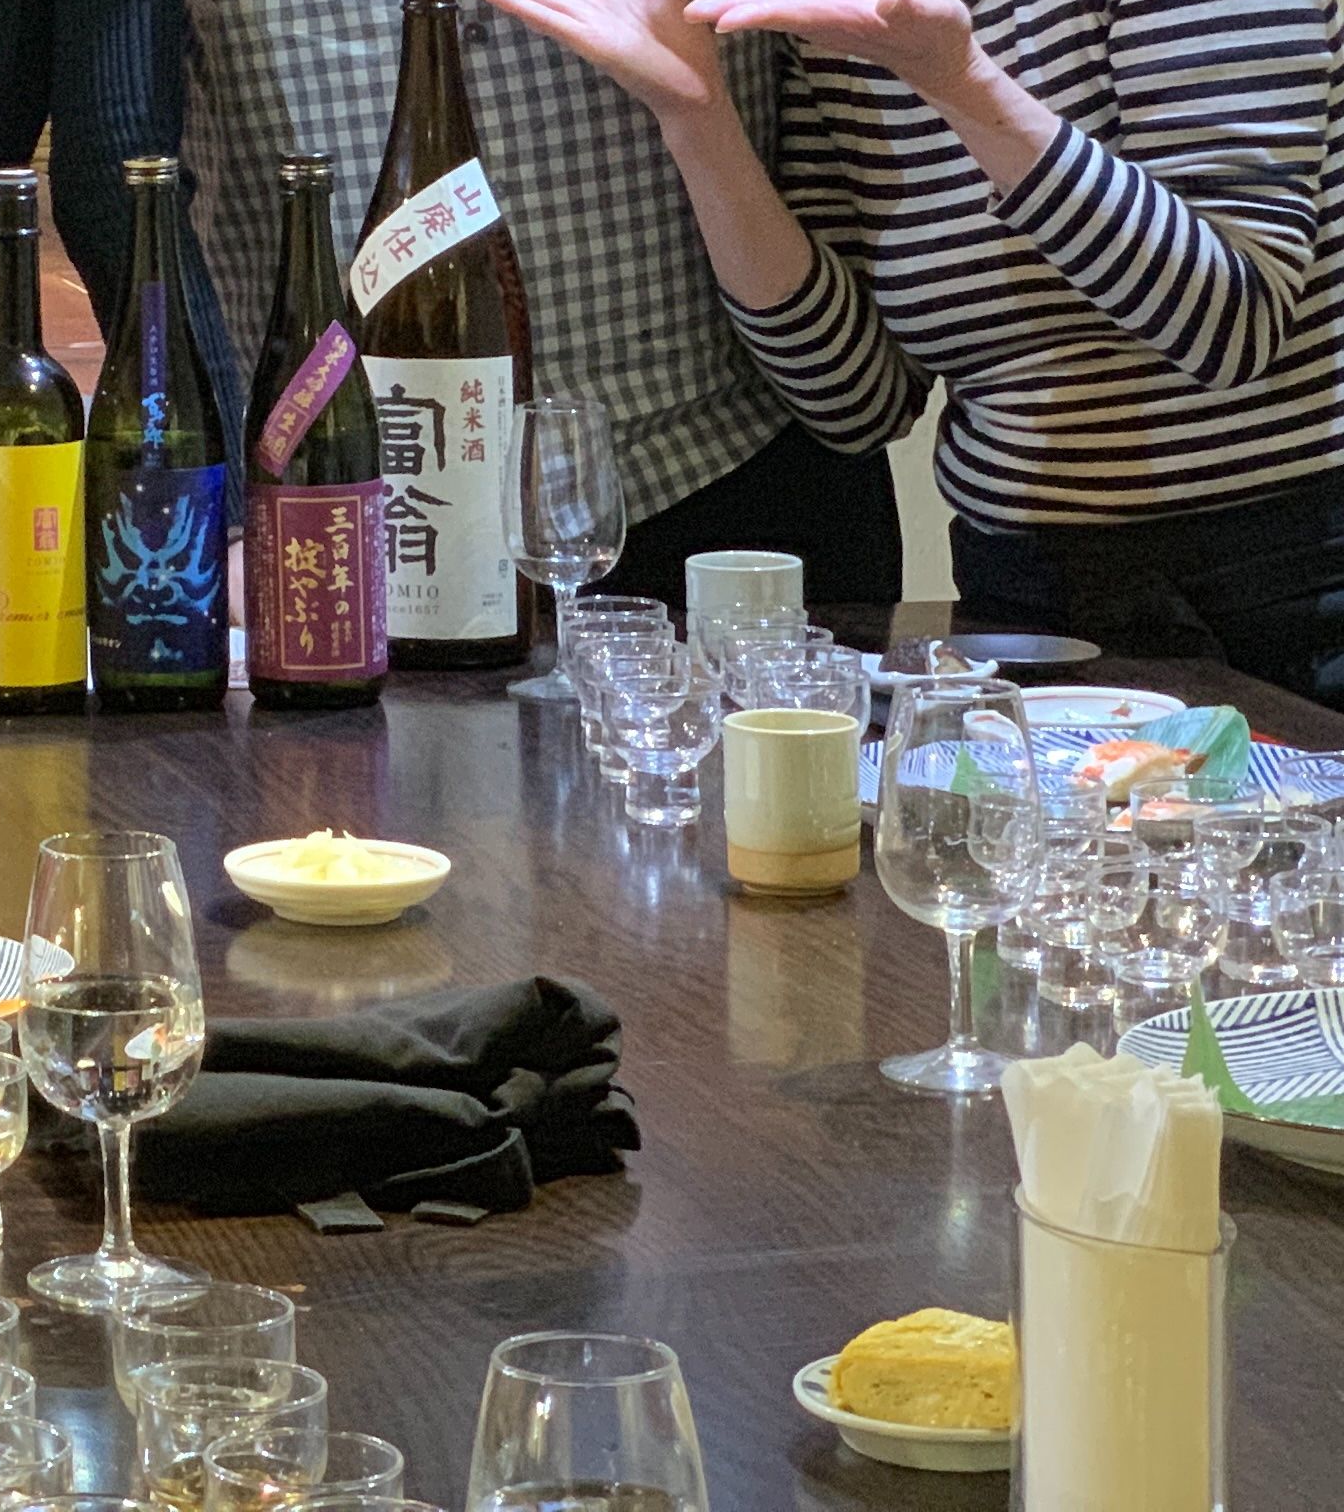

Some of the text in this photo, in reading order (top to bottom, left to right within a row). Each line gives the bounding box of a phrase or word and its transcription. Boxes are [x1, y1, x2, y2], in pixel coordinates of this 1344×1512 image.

[358, 183, 482, 296] 山廃仕込
[459, 378, 486, 463] 純米酒
[324, 506, 355, 615] 三百年の
[385, 584, 440, 600] OMIO
